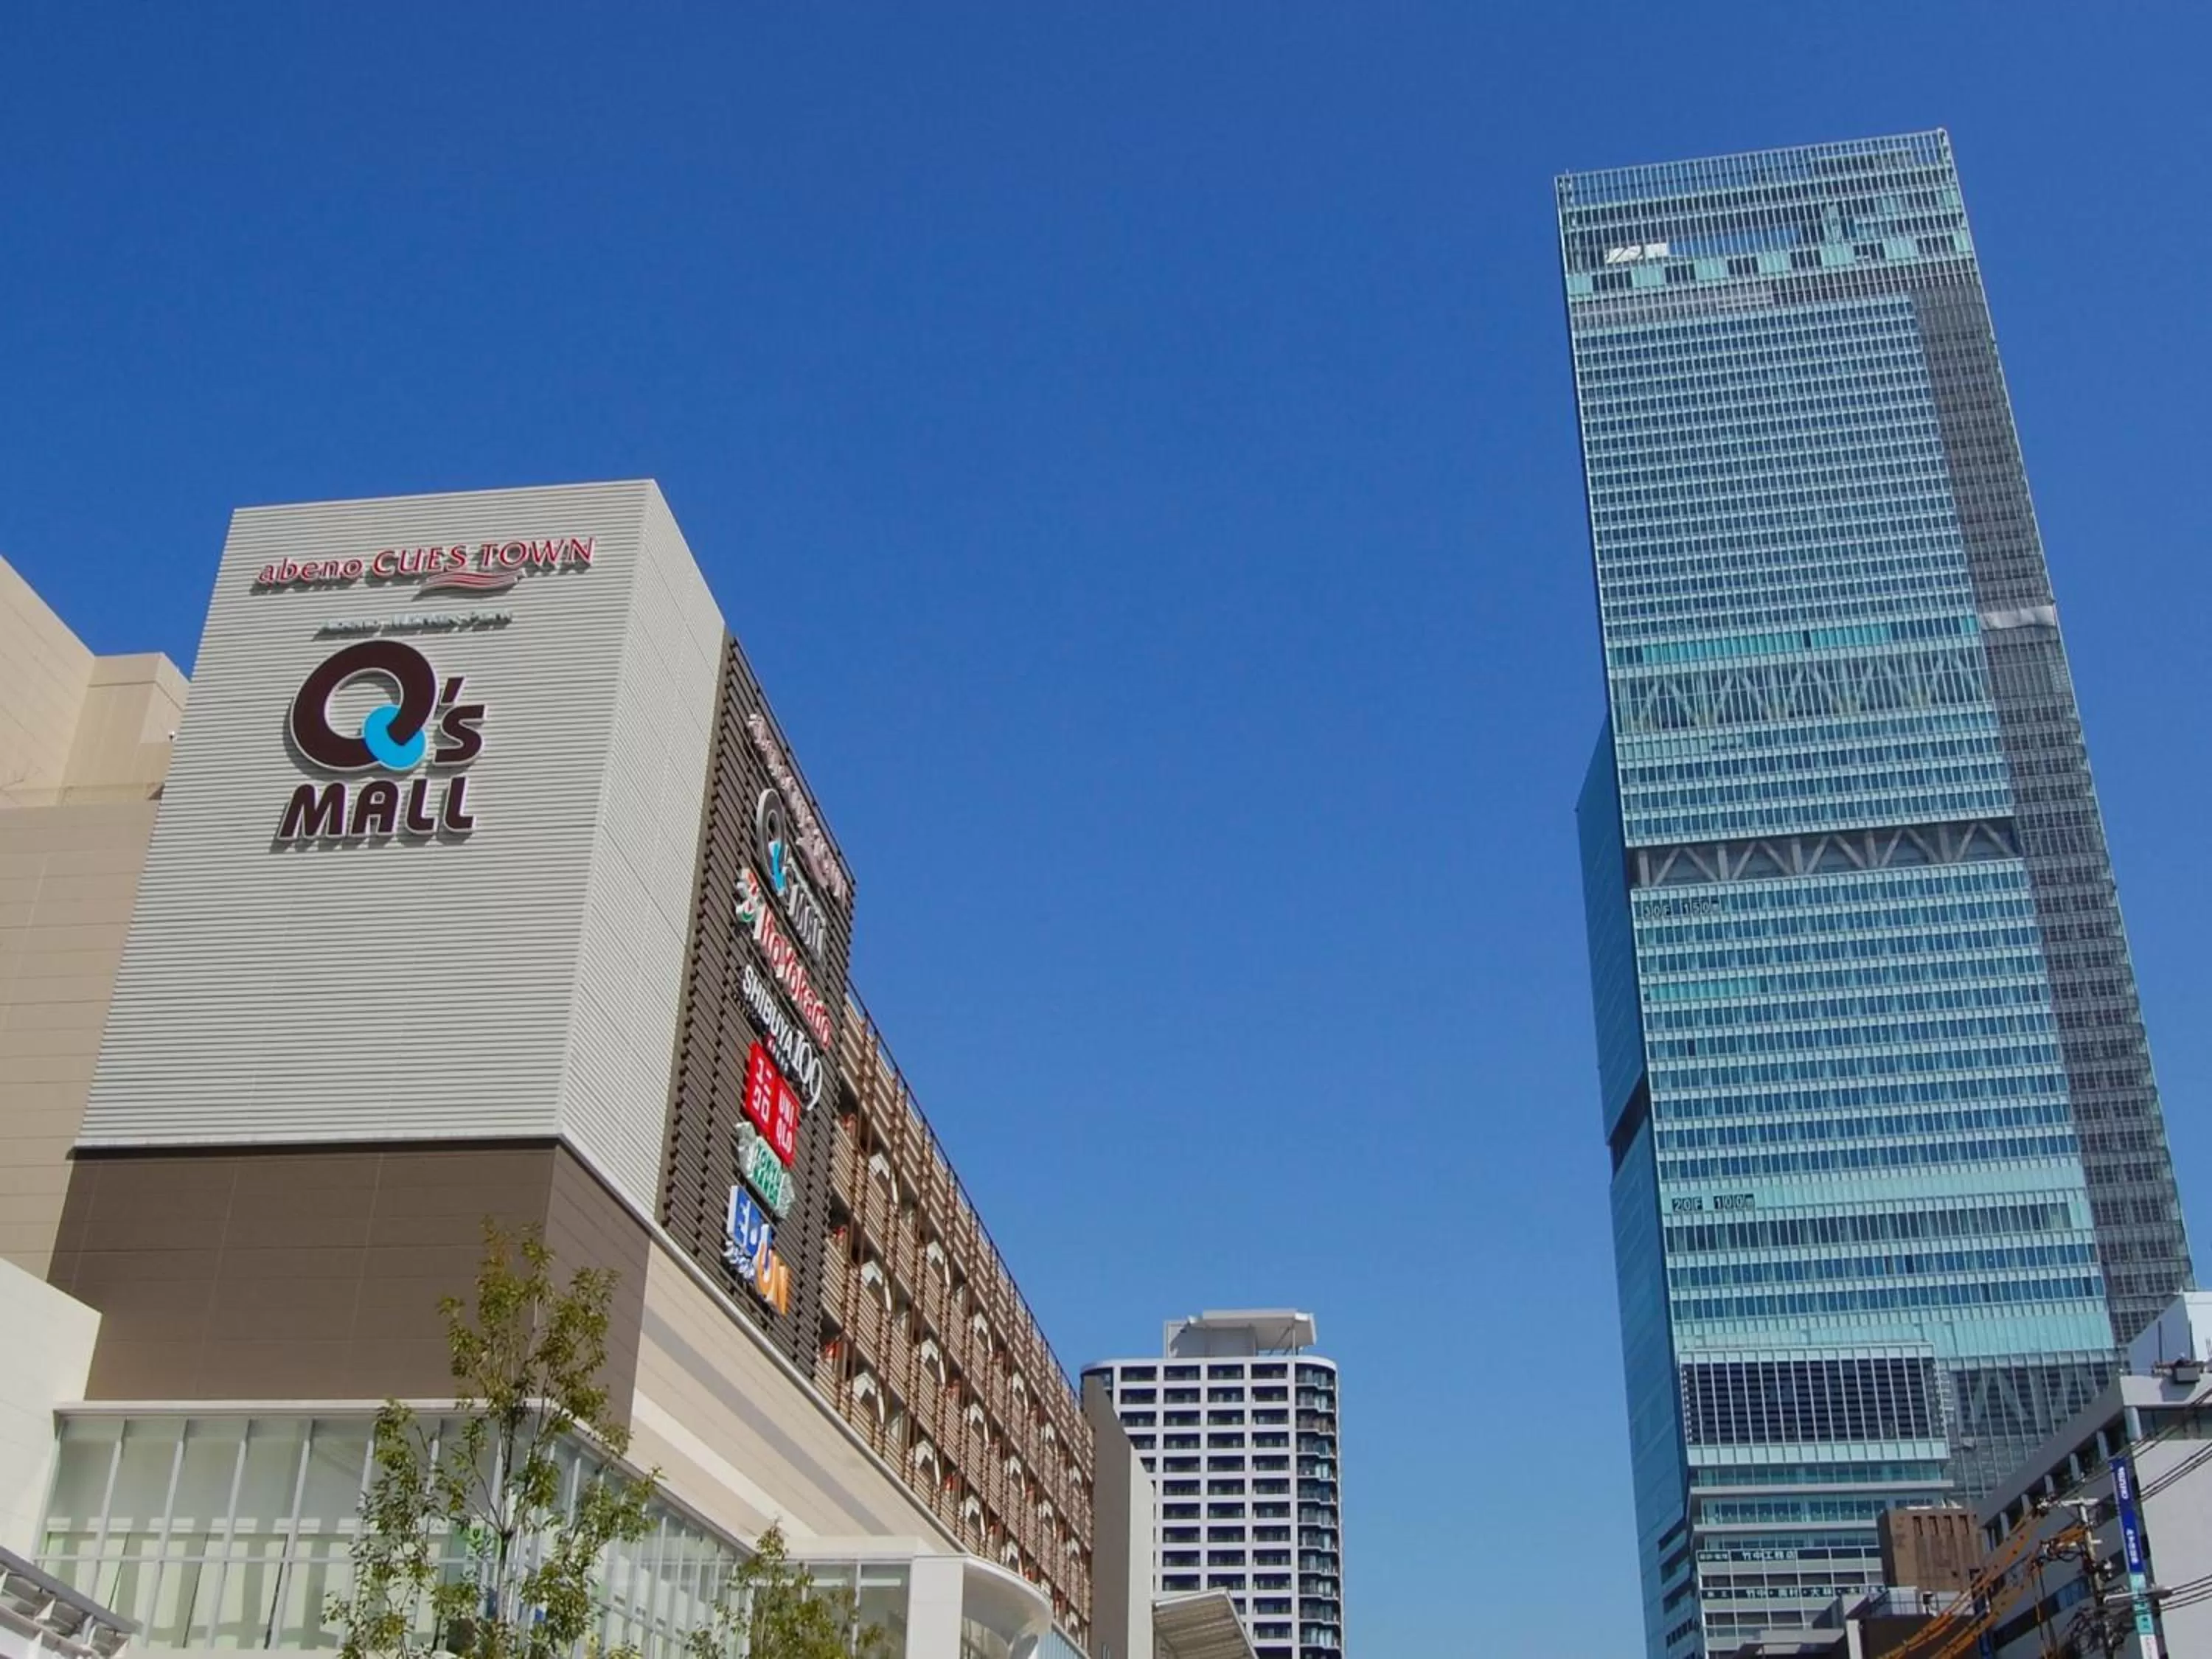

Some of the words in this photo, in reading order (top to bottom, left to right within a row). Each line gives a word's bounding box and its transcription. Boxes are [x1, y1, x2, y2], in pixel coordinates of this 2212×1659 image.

[258, 556, 364, 585] abeno
[372, 543, 469, 578] CUES
[480, 535, 597, 570] TOWN
[276, 776, 478, 841] MALL
[1672, 1198, 1703, 1213] 20F
